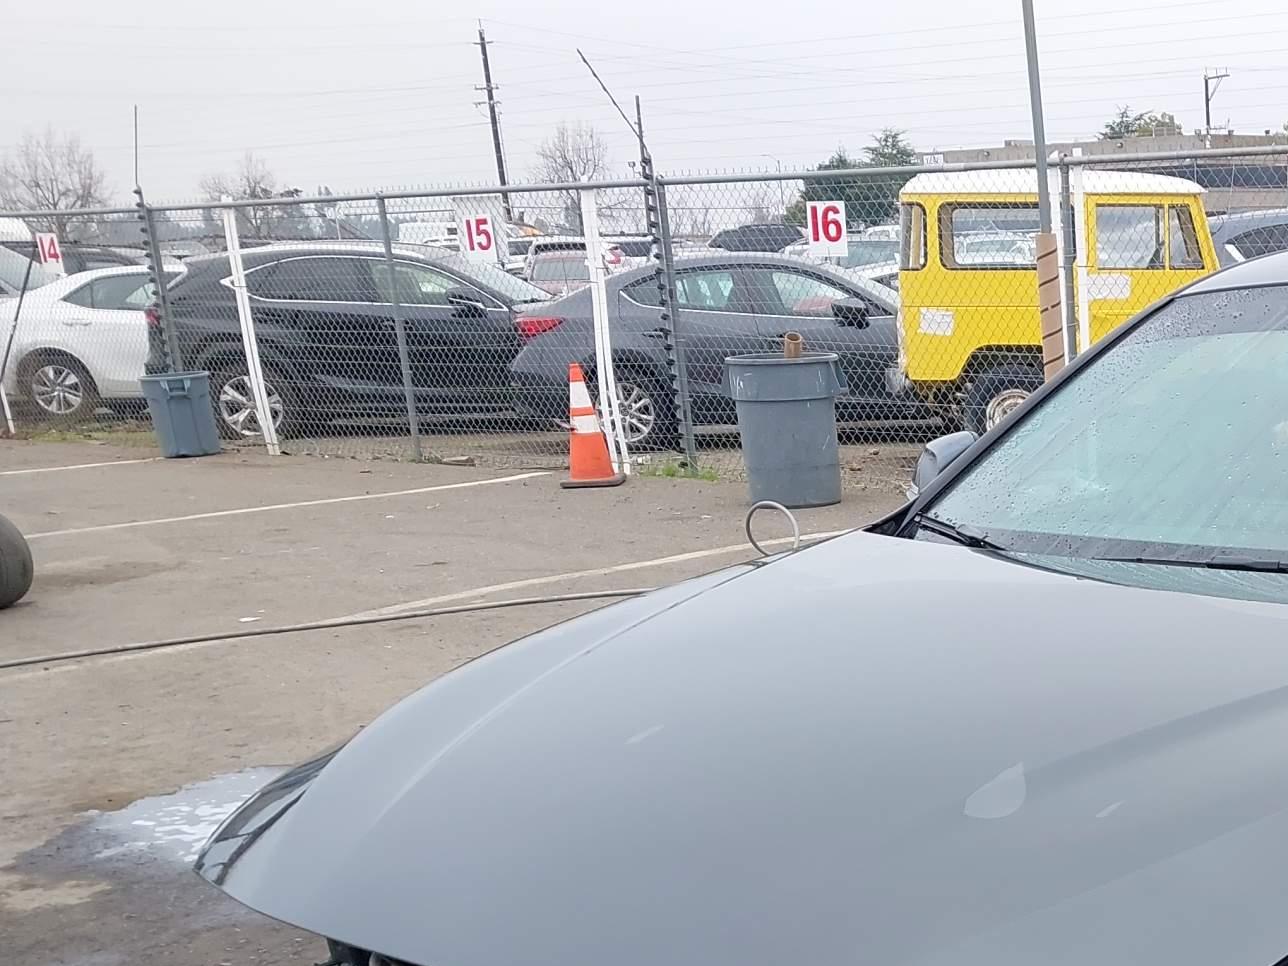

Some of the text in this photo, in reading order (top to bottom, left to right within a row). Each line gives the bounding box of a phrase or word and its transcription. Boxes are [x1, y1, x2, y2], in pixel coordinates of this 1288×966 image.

[466, 217, 492, 251] 15
[810, 204, 843, 243] 16
[39, 236, 60, 263] 14
